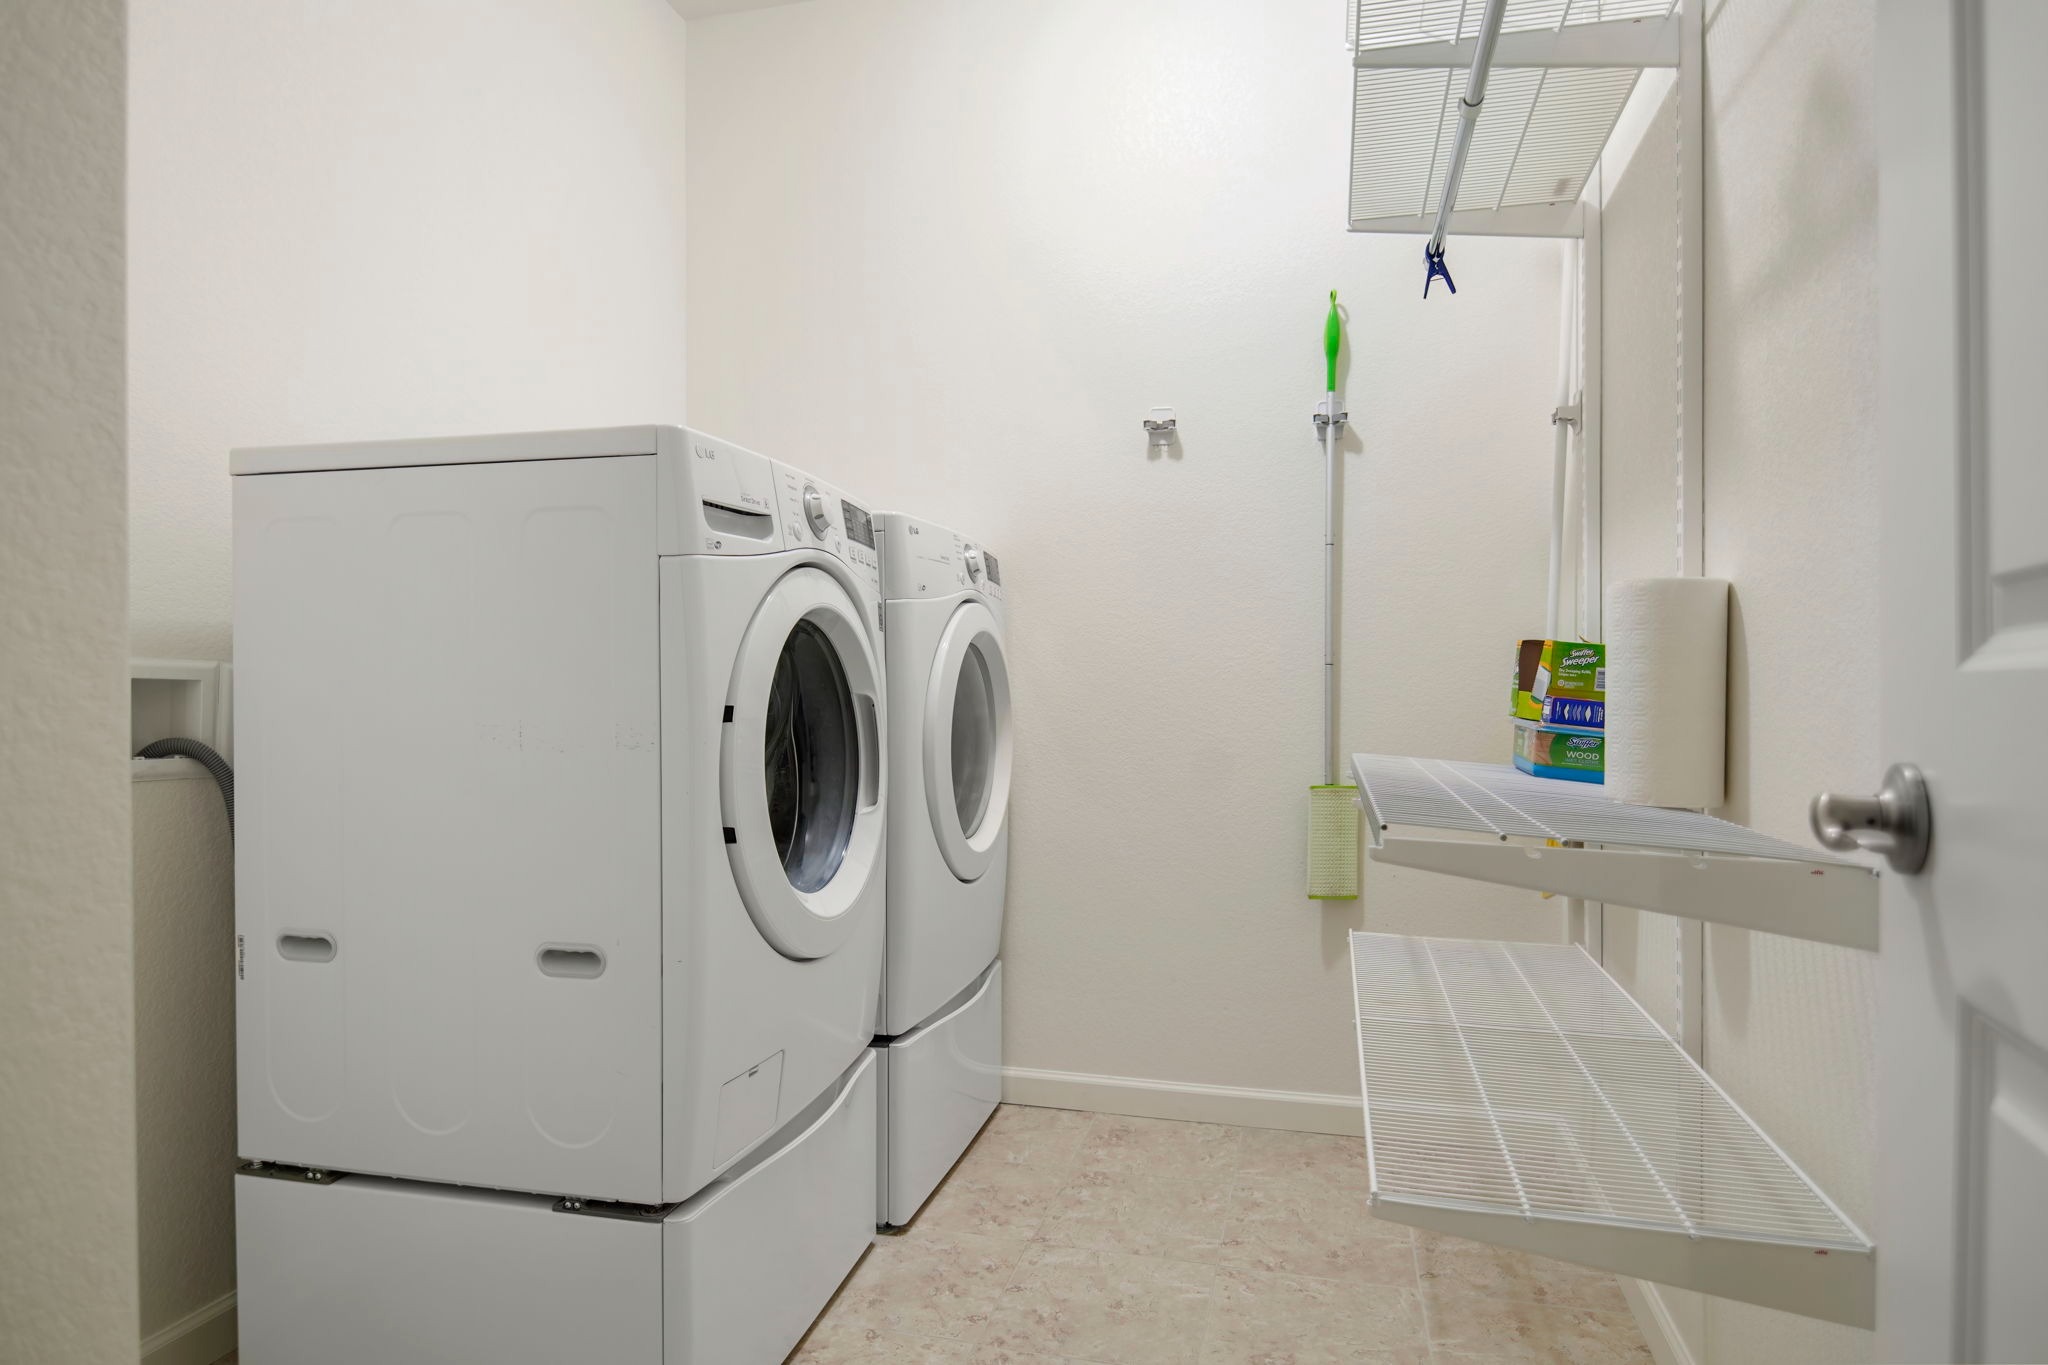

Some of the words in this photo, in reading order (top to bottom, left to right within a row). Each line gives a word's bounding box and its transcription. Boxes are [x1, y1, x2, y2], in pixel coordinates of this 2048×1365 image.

[1560, 656, 1600, 668] Sweeper
[1567, 737, 1600, 748] Swiffer
[1566, 751, 1600, 760] WOOD
